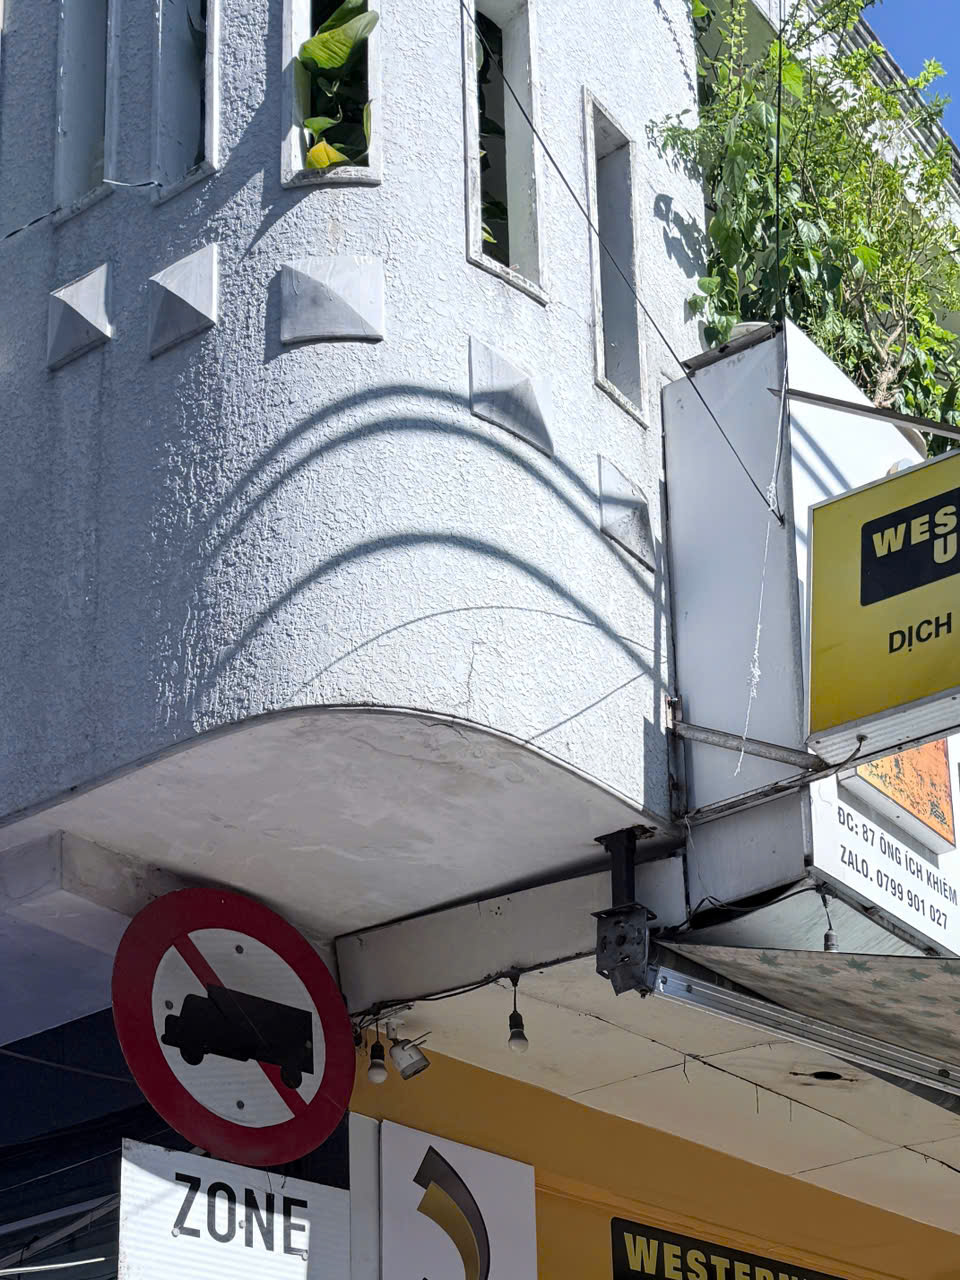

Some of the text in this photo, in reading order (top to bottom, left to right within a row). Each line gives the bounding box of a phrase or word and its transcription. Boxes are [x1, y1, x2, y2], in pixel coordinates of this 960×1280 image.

[889, 612, 952, 654] DỊCH
[840, 844, 948, 930] ZALO. 0799 901 027
[862, 823, 875, 848] 87
[879, 832, 902, 866] ÔNG
[905, 852, 923, 882] ÍCH
[172, 1171, 309, 1256] ZONE
